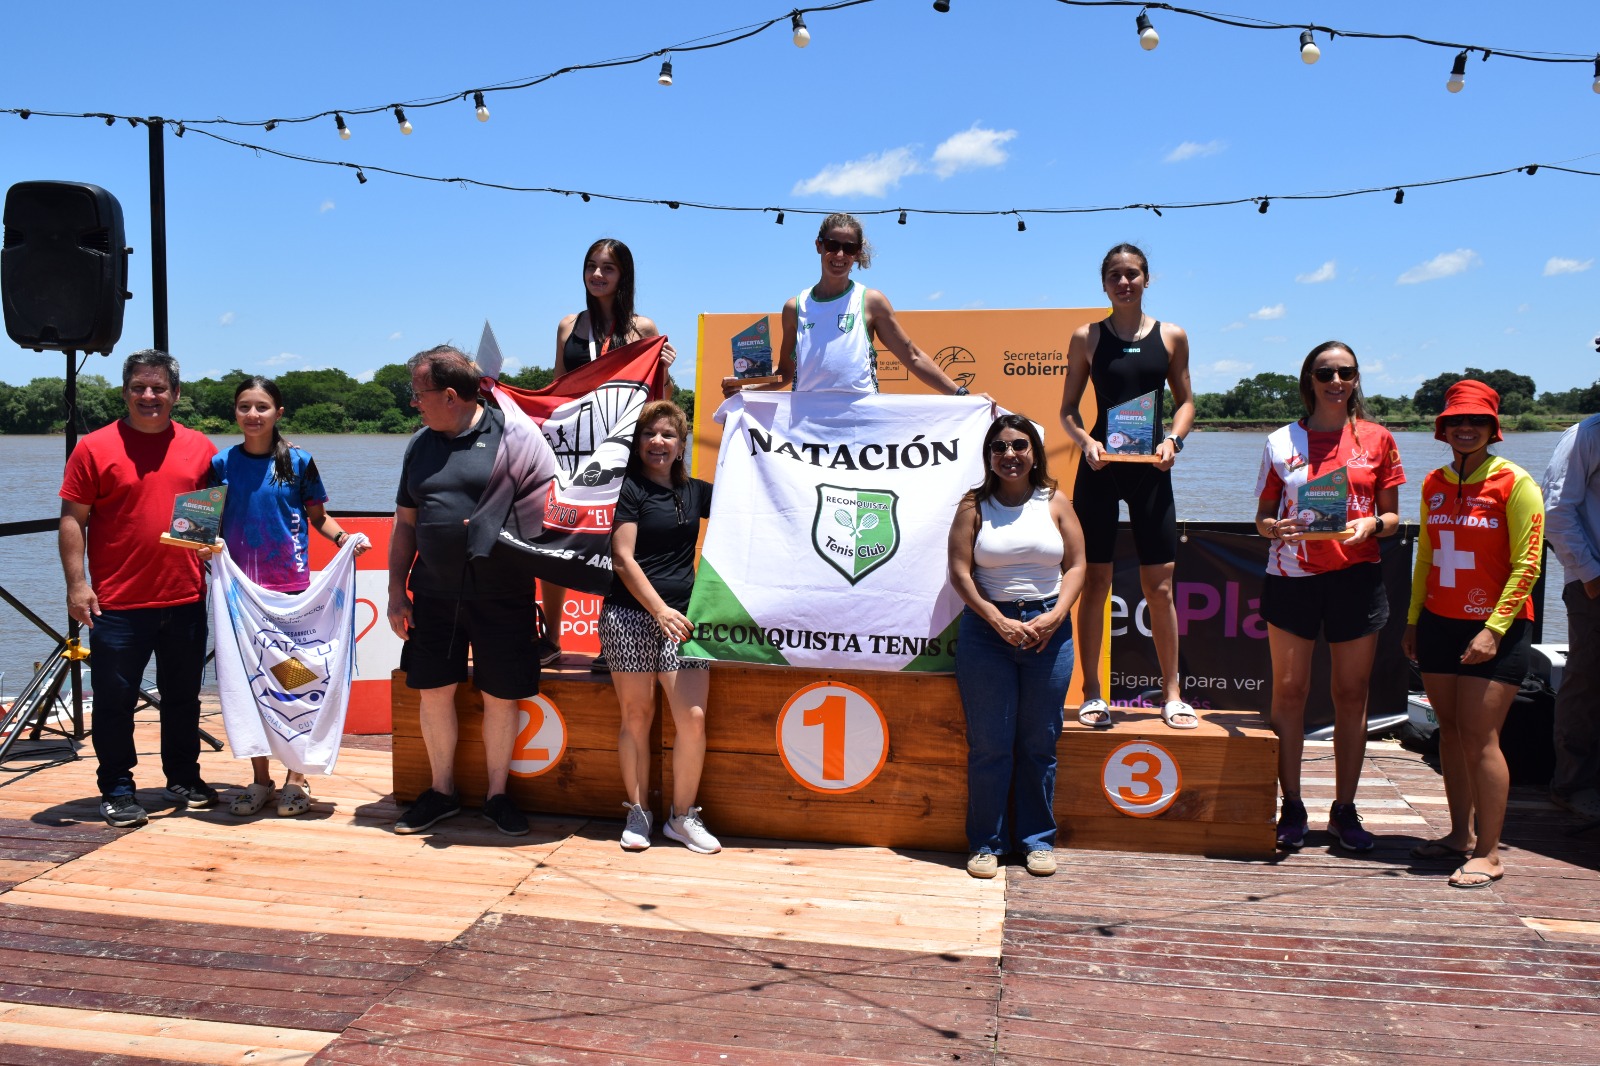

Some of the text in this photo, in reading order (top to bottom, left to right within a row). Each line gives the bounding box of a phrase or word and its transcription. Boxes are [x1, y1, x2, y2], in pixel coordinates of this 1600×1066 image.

[1003, 350, 1063, 361] Secretaría
[1003, 362, 1070, 376] Gobiern
[748, 428, 960, 471] NATACIÓN
[826, 495, 890, 511] RECONQUISTA
[1427, 514, 1499, 529] ARDAVIDAS
[291, 513, 306, 573] NATALU
[825, 536, 886, 558] Tenis Club
[1498, 513, 1543, 617] GUARDAVIDAS
[1464, 605, 1494, 614] Goya
[868, 635, 941, 657] TENIS
[1110, 671, 1265, 691] Gigare para ver
[511, 699, 550, 760] 2
[803, 695, 847, 781] 1
[1118, 751, 1164, 805] 3
